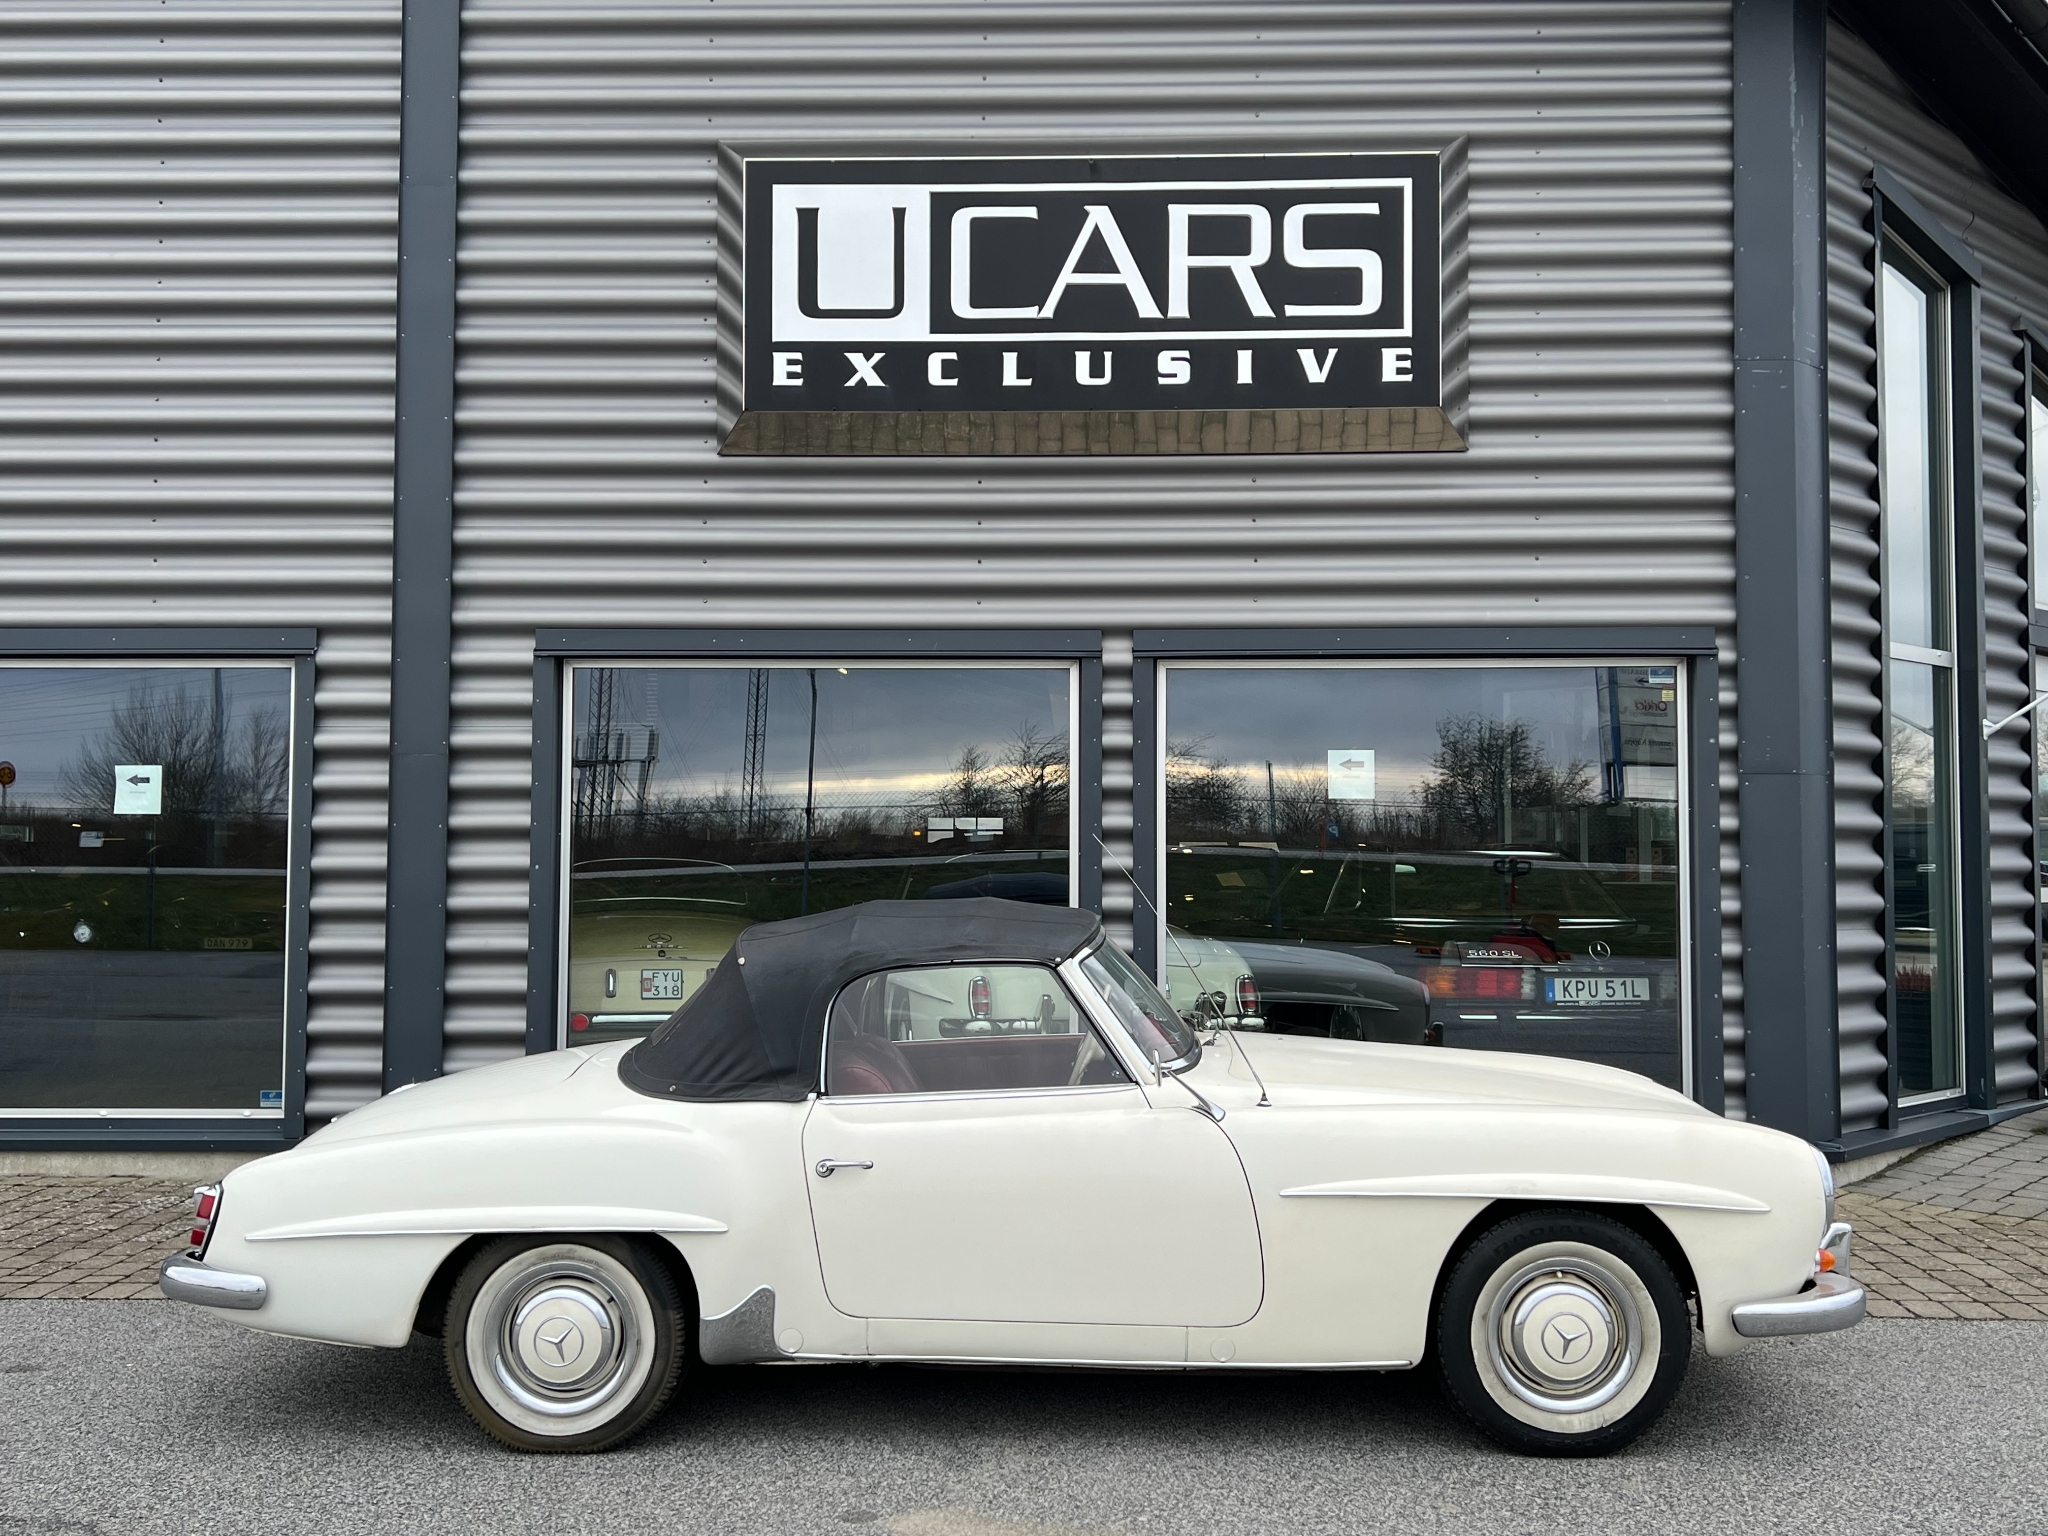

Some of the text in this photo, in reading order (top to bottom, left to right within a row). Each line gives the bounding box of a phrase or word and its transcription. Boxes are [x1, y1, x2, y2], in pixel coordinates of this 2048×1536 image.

[772, 347, 1413, 387] EXCLUSIVE
[1468, 949, 1519, 957] 560 SL
[652, 972, 679, 982] FYU
[652, 985, 680, 996] 318
[1562, 980, 1599, 998] KPU
[1605, 980, 1641, 998] 51L
